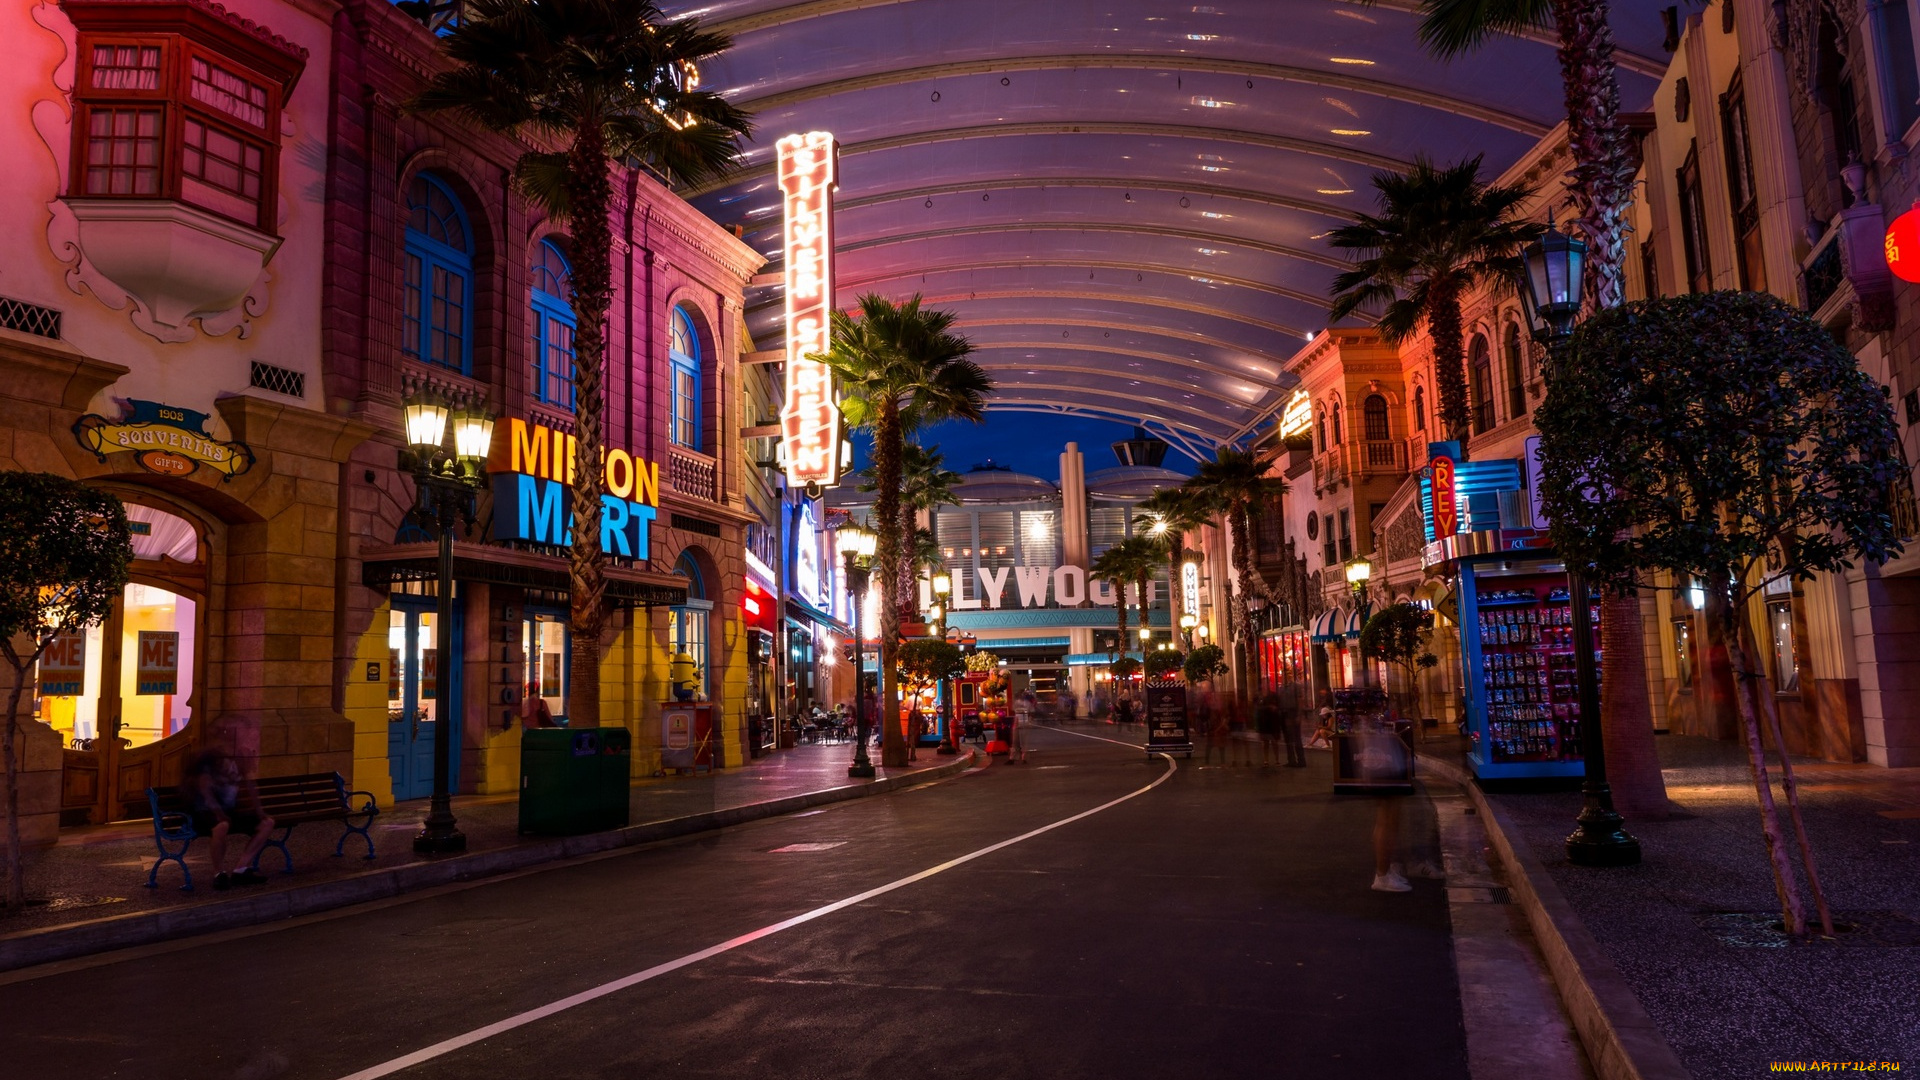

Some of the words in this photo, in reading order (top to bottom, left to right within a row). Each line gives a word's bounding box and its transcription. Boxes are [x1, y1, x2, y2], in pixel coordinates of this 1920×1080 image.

[793, 149, 818, 299] SILVER
[796, 317, 824, 472] SCREEN
[159, 409, 184, 421] 1908
[118, 430, 223, 462] SOUVENIRS
[154, 457, 184, 470] GIFTS
[1435, 466, 1453, 536] REY
[130, 523, 149, 533] ART
[518, 473, 656, 561] MRT
[44, 638, 81, 666] ME
[142, 641, 174, 667] ME
[41, 682, 80, 693] MART
[140, 682, 173, 693] MART
